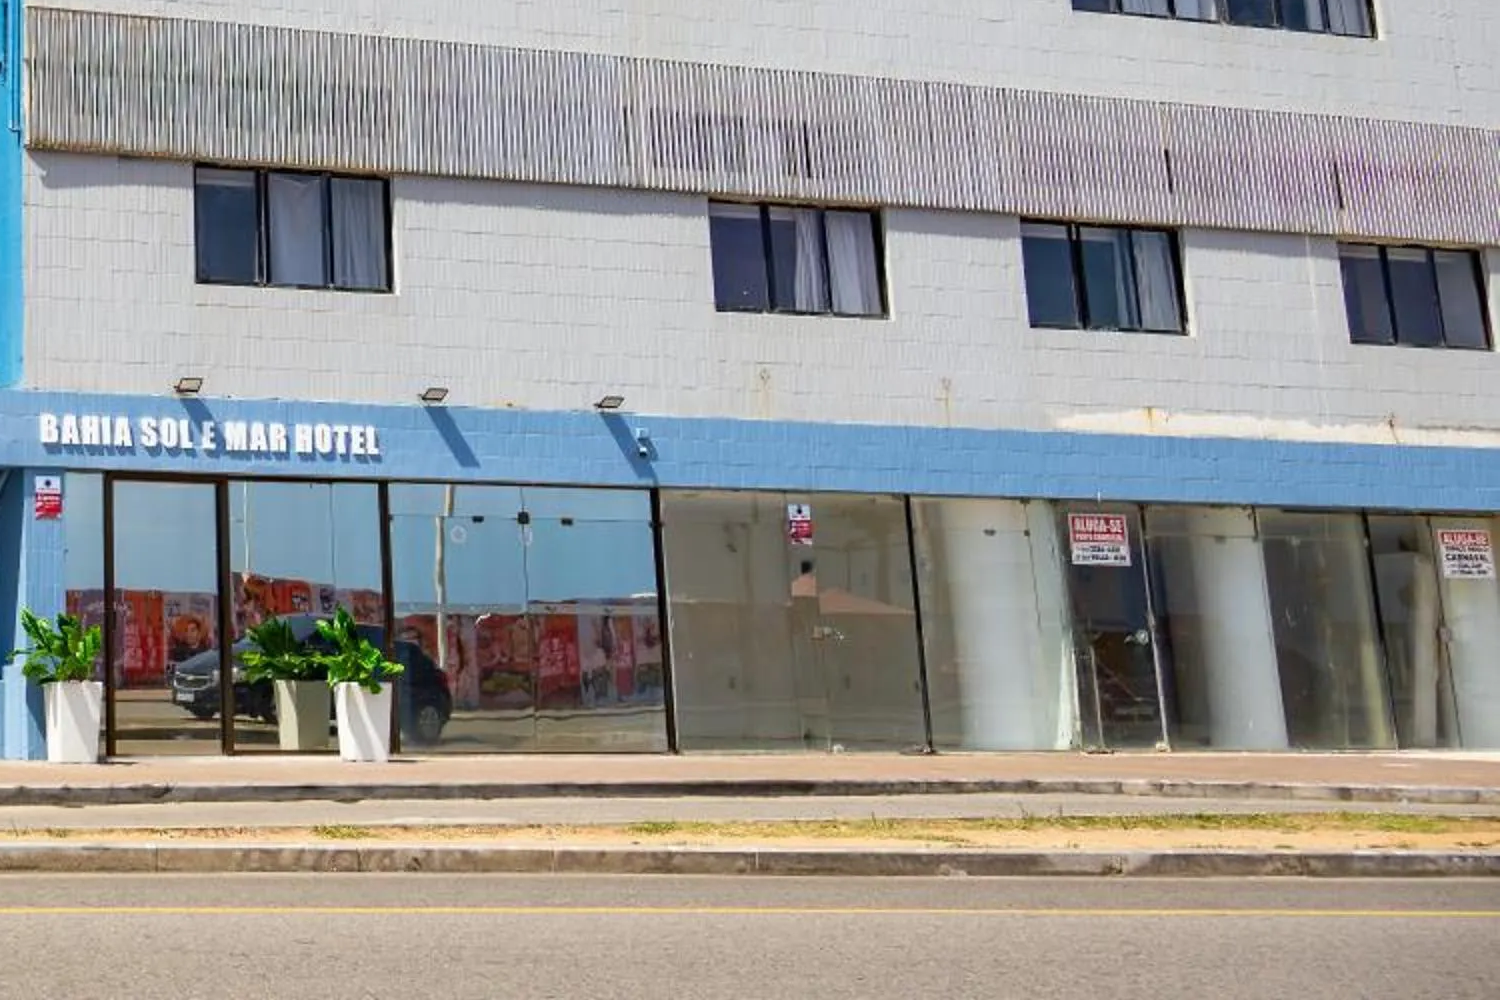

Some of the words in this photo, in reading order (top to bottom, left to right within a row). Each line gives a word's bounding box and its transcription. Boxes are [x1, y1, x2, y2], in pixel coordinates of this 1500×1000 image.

[40, 412, 132, 447] BAHIA
[140, 416, 193, 449] SOL
[202, 421, 216, 449] E
[224, 421, 287, 452] MAR
[296, 423, 379, 454] HOTEL
